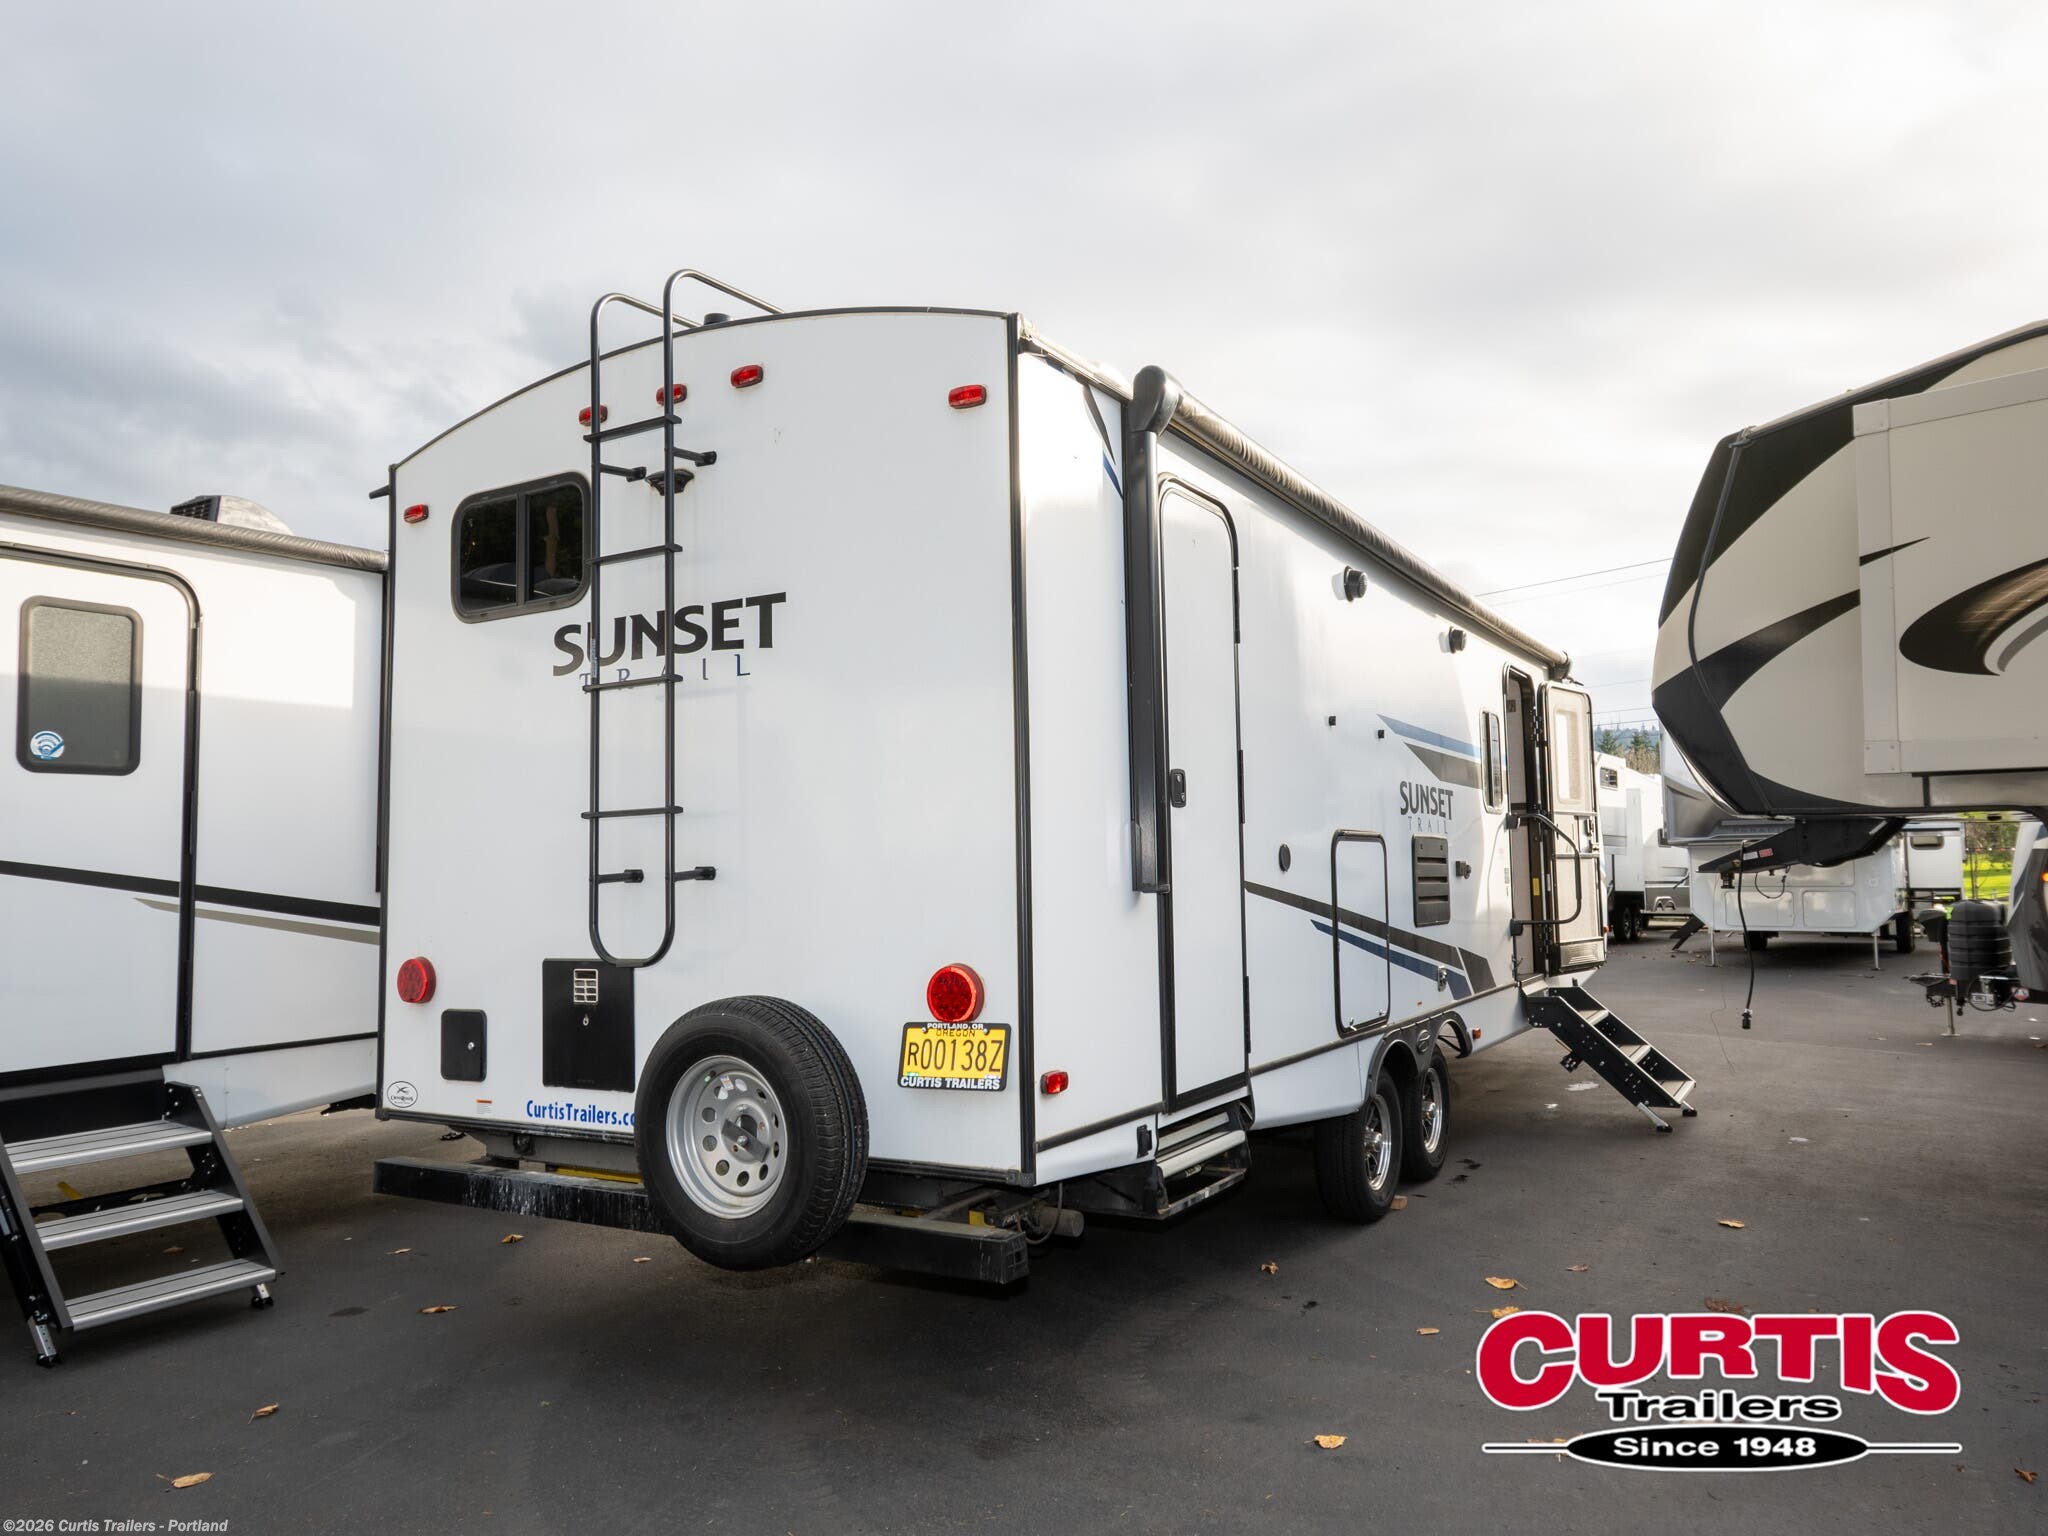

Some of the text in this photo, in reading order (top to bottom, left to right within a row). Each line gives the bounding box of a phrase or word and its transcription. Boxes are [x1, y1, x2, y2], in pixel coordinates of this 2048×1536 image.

[553, 591, 787, 677] SUNSET
[1399, 780, 1454, 820] SUNSET
[1408, 816, 1448, 834] TRAIL
[907, 1039, 1003, 1072] R00138Z
[900, 1076, 1001, 1090] CURTIS TRAILERS
